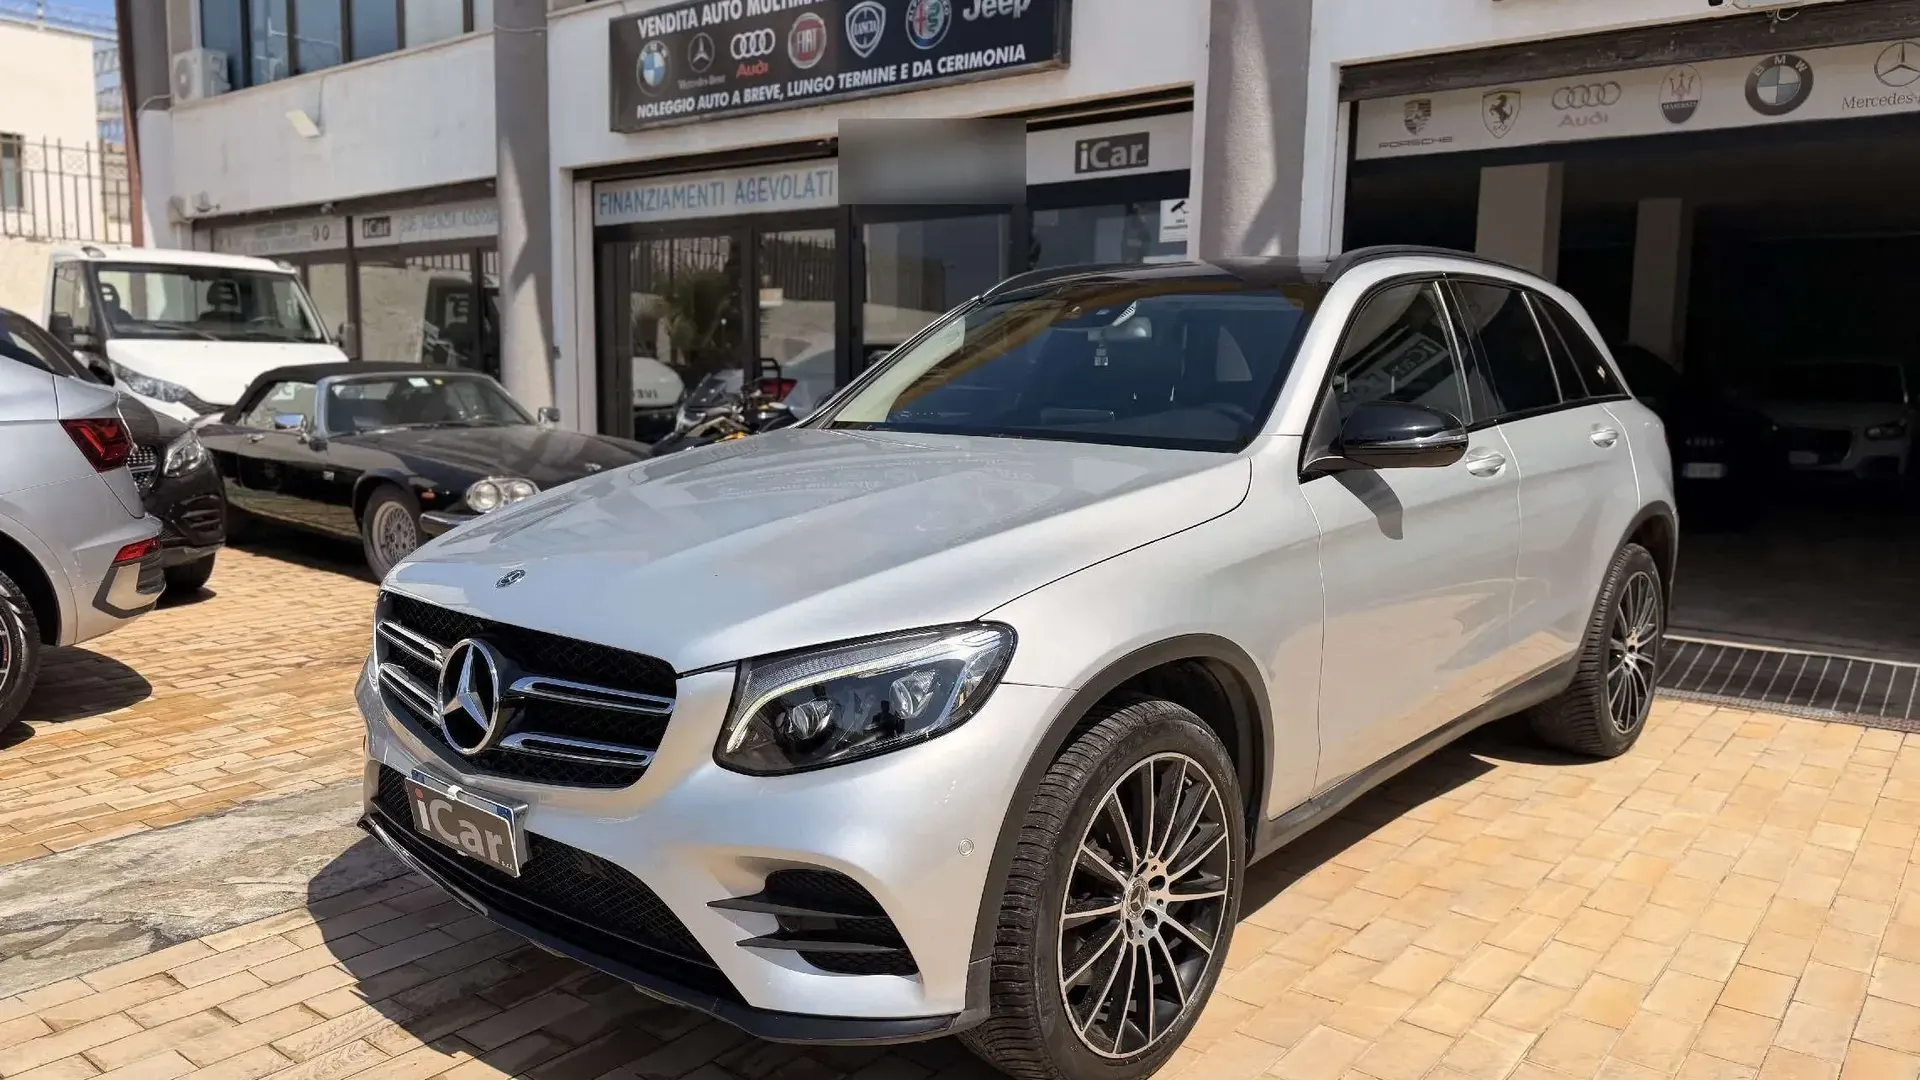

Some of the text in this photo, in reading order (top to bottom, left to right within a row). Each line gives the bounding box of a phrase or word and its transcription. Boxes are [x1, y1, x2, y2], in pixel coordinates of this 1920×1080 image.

[637, 7, 698, 39] VENDITA
[701, 0, 742, 26] AUTO
[963, 0, 1031, 21] Jeep
[854, 20, 877, 36] LANCIA
[797, 28, 817, 53] FIAT
[736, 60, 769, 78] Audi
[1754, 54, 1808, 77] BMW
[637, 44, 1026, 118] NOLEGGIO AUTO A BREVE, LUNGO TERMINE E DA CERIMONIA
[1841, 92, 1920, 110] Mercedes-
[1557, 111, 1609, 128] Audi
[1378, 136, 1453, 149] PORSCHE
[1080, 141, 1144, 170] iCar
[599, 170, 834, 215] FINANZIAMENTI AGEVOLATI
[414, 787, 503, 863] iCar
